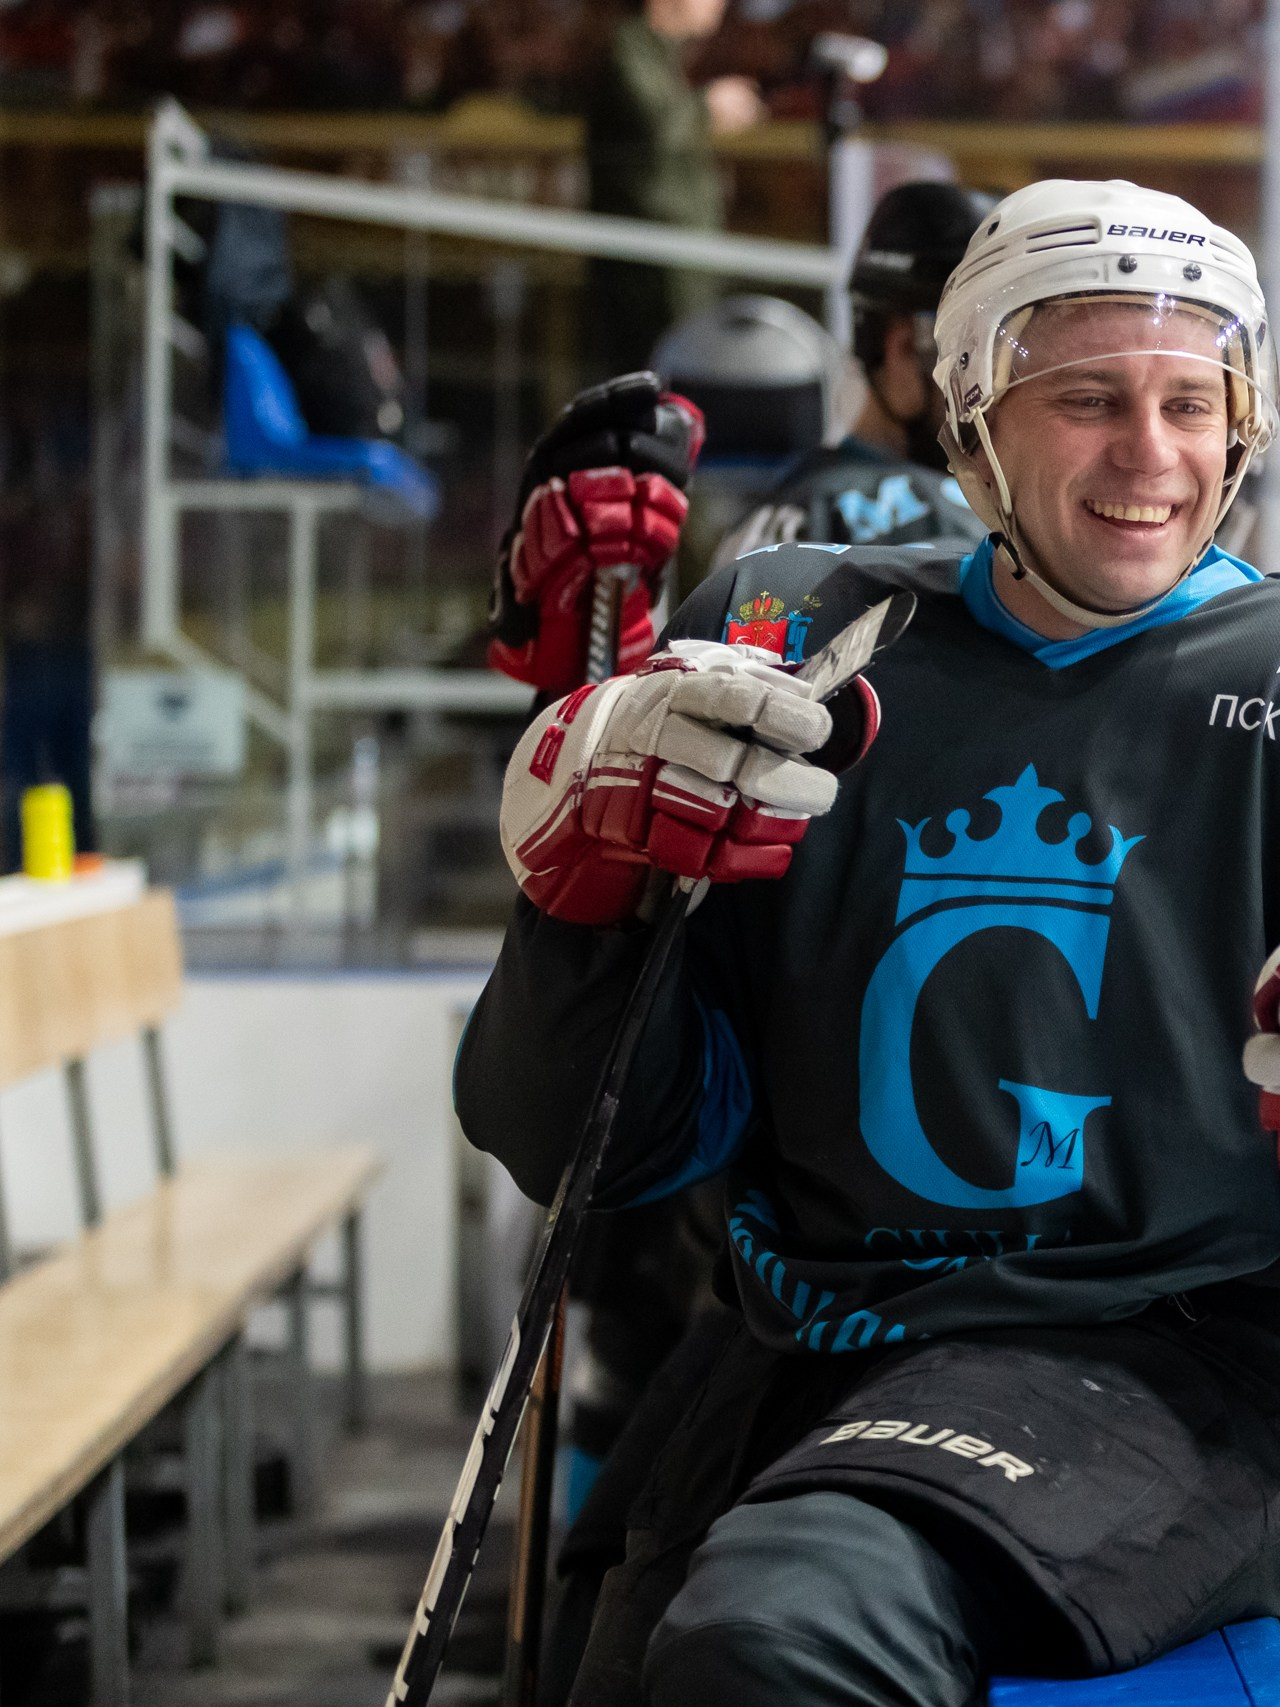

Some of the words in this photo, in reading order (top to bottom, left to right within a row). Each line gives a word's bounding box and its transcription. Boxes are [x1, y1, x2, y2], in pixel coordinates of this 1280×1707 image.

[1106, 223, 1206, 247] BAUER
[1020, 1121, 1081, 1170] M
[818, 1420, 1035, 1483] BAUER
